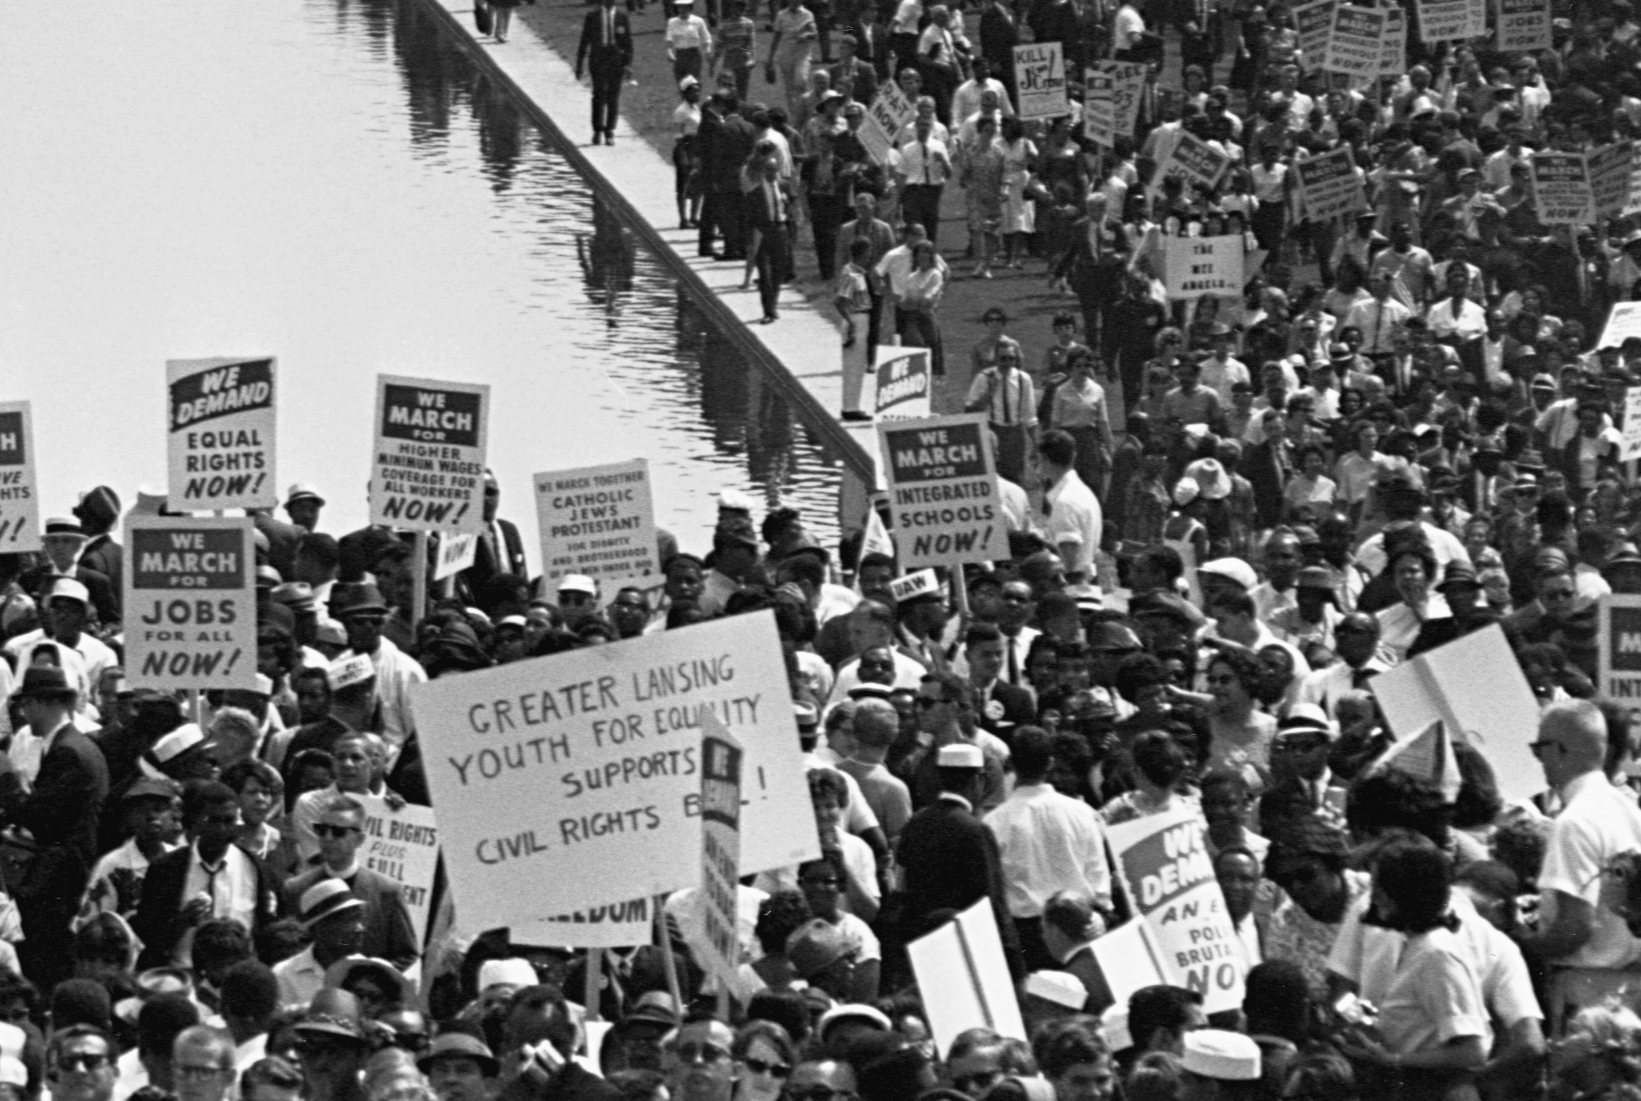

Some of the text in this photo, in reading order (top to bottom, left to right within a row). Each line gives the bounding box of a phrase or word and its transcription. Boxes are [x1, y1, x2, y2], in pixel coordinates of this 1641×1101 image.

[201, 366, 241, 394] WE
[890, 357, 910, 381] WE
[417, 391, 446, 409] WE
[878, 372, 926, 407] DEMAND
[176, 381, 269, 425] DEMAND
[389, 405, 472, 431] MARCH
[187, 429, 262, 450] EQUAL
[412, 429, 446, 441] FOR
[918, 429, 949, 446] WE
[187, 451, 265, 473] RIGHTS
[400, 443, 461, 460] HIGHER
[897, 445, 978, 469] MARCH
[378, 453, 482, 476] MINIMUM WAGES
[924, 465, 956, 477] FOR
[184, 472, 267, 500] NOW!
[381, 468, 477, 489] COVERAGE FOR
[384, 481, 471, 500] ALL WORKERS
[553, 489, 633, 509] CATHOLIC
[896, 481, 991, 505] INTEGRATED
[382, 497, 470, 525] NOW!
[570, 505, 618, 521] JEWS
[900, 504, 994, 528] SCHOOLS
[551, 516, 640, 537] PROTESTANT
[171, 533, 204, 549] WE
[913, 525, 993, 556] NOW!
[140, 552, 236, 573] MARCH
[170, 576, 207, 586] FOR
[894, 574, 927, 597] UAW
[142, 600, 236, 625] JOBS
[145, 631, 234, 642] FOR ALL
[142, 647, 242, 676] NOW!
[469, 653, 735, 736] GREATER LANSING
[448, 714, 644, 787] YOUTH FOR
[562, 747, 697, 798] SUPPORTS
[389, 820, 437, 846] RIGHTS
[475, 805, 661, 865] CIVIL RIGHTS
[1164, 822, 1206, 859] WE
[371, 841, 407, 860] PLUS
[1161, 901, 1199, 925] AN
